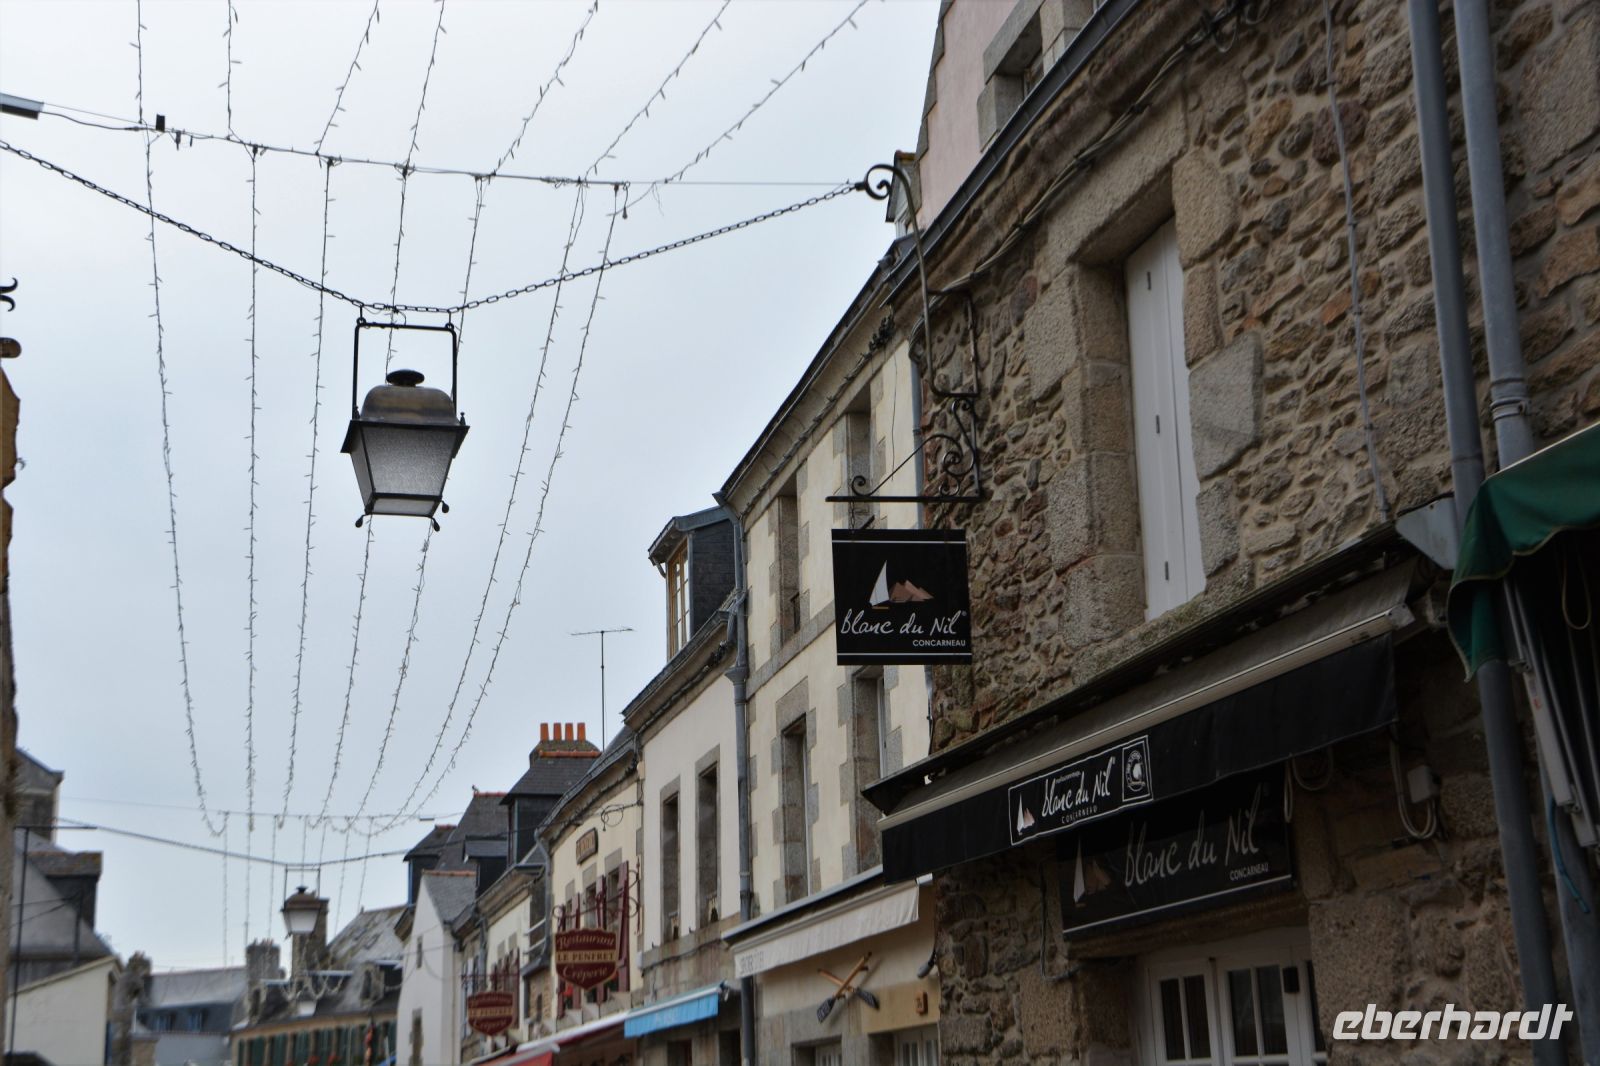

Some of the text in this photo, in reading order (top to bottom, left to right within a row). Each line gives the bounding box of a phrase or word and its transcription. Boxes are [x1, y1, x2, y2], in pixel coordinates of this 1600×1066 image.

[899, 612, 925, 634] du
[912, 639, 966, 647] CONCARNEAU
[1075, 771, 1090, 806] du
[1061, 804, 1098, 824] CONCARNEAU
[1188, 810, 1217, 871] du
[1229, 862, 1269, 881] CONCARNEAU
[557, 952, 568, 961] LE
